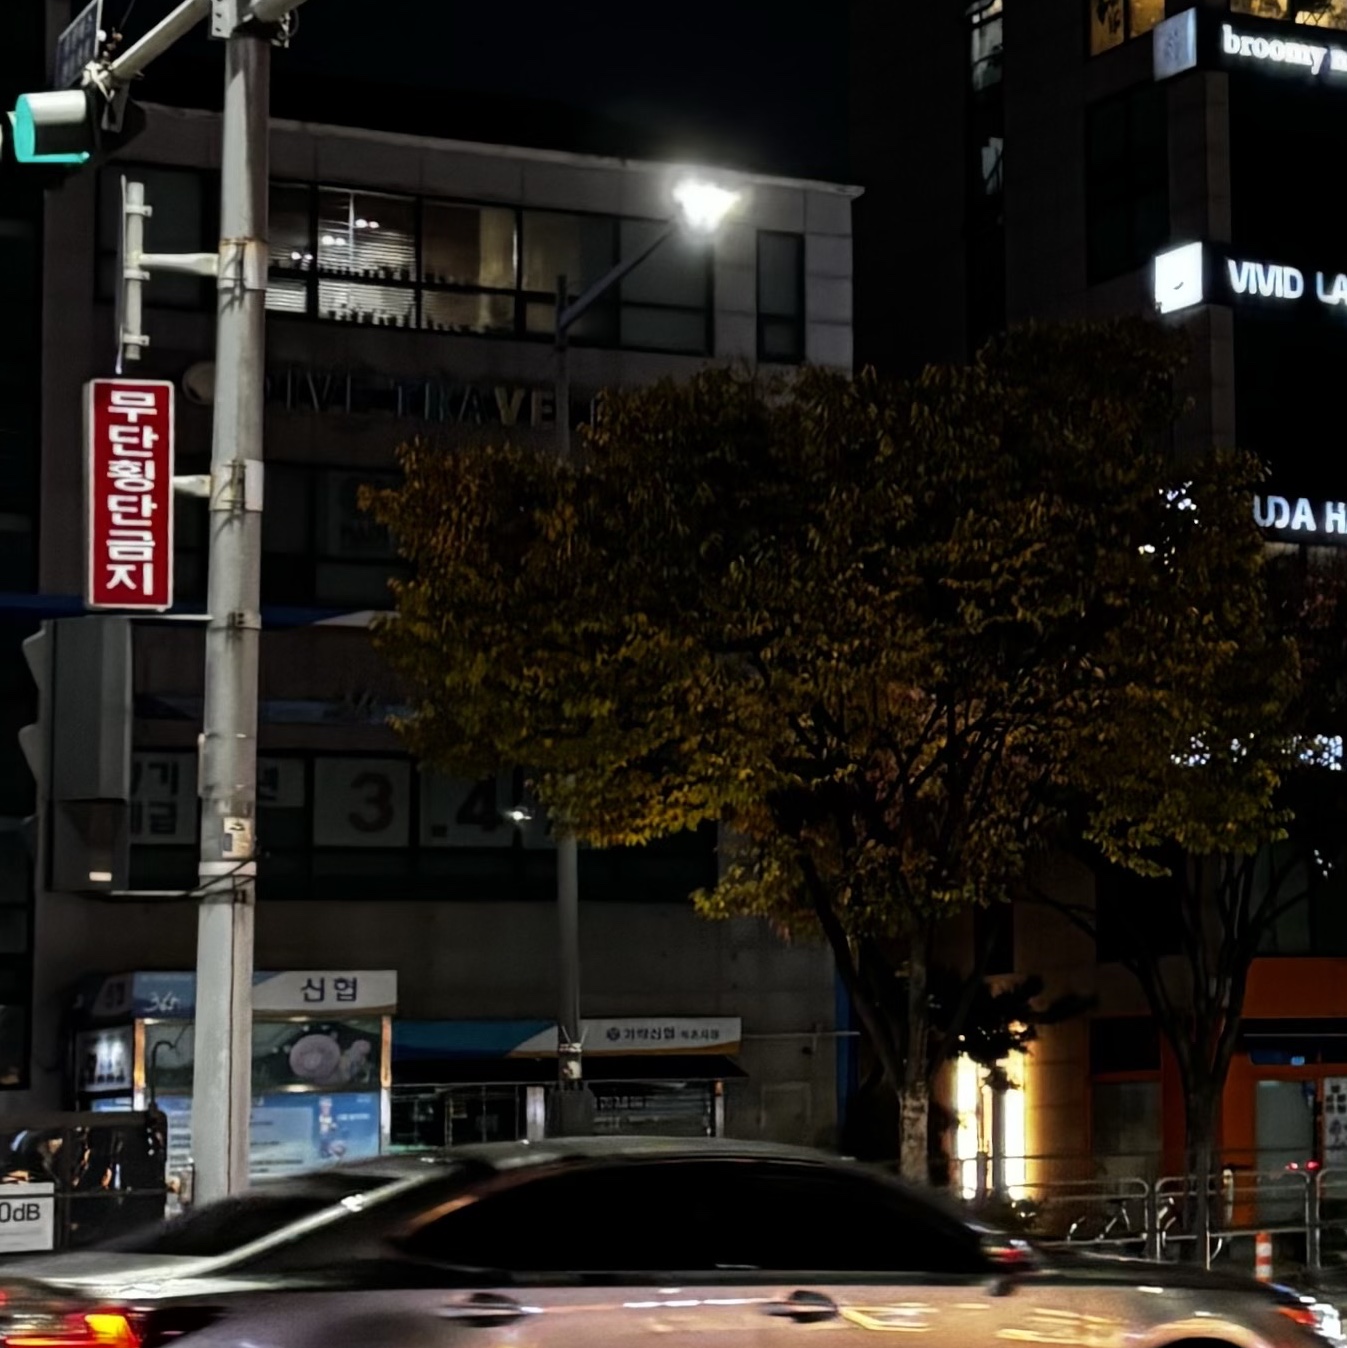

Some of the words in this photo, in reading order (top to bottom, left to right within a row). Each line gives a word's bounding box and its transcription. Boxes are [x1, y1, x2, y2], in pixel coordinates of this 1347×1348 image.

[1222, 24, 1327, 75] broomy
[1226, 258, 1304, 299] VIVID
[106, 390, 159, 596] 무단횡단금지
[302, 976, 358, 1003] 신협
